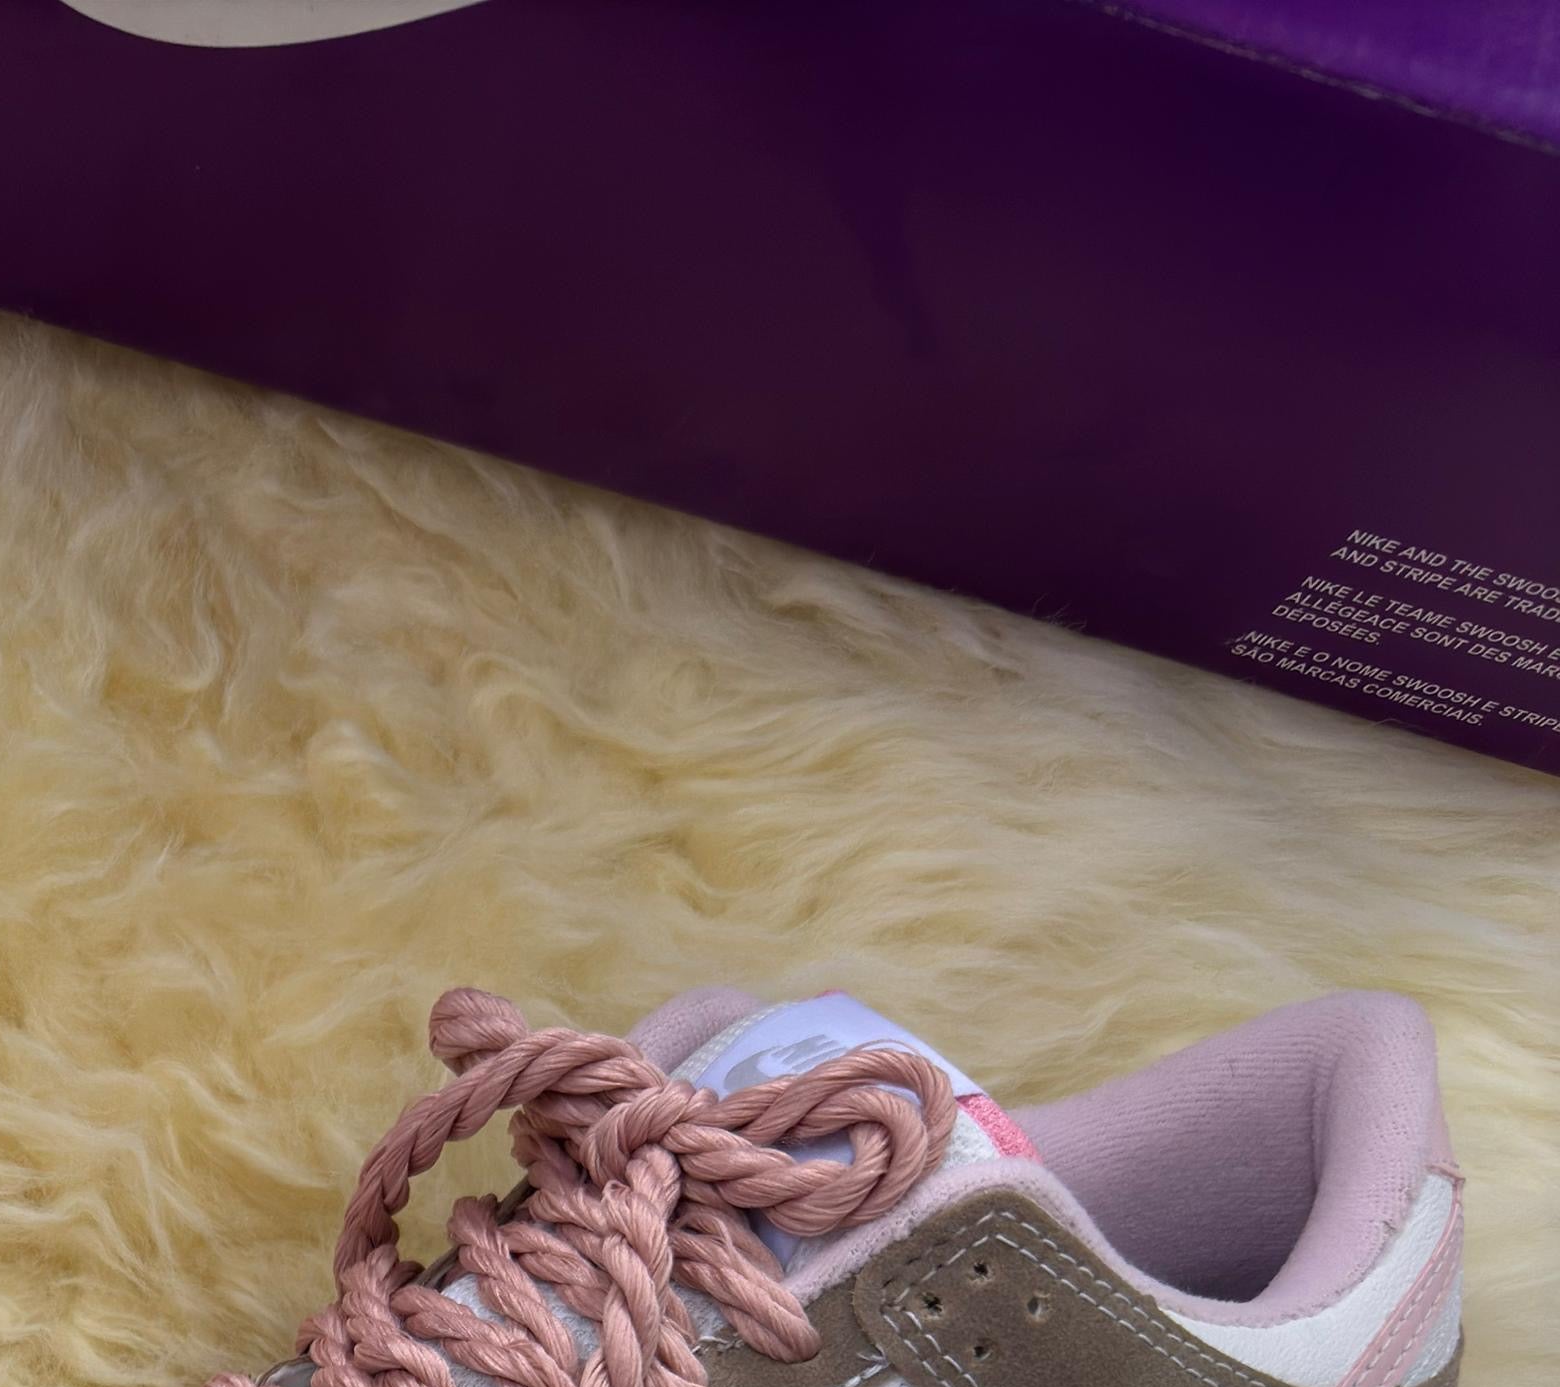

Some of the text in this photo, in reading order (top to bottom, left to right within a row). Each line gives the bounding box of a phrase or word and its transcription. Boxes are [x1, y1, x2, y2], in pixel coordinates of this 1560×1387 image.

[1330, 546, 1378, 567] AND
[1380, 560, 1456, 590] STRIPE
[1454, 582, 1503, 603] ARE
[1347, 530, 1401, 553] NIKE
[1398, 546, 1446, 567] AND
[1450, 559, 1493, 581] THE
[1272, 605, 1382, 645] DÉPOSÉES.
[1285, 591, 1410, 634] ALLÉGEACE
[1410, 626, 1469, 650] SONT
[1467, 643, 1512, 663] DES
[1301, 576, 1353, 598] NIKE
[1352, 591, 1383, 607] LE
[1384, 599, 1456, 628] TEAME
[1456, 621, 1548, 655] SWOOSH
[1231, 644, 1485, 727] SÃO MARCAS COMERCIAIS.
[1244, 631, 1294, 652] NIKE
[1294, 645, 1312, 658] E
[1312, 652, 1330, 663] O
[1331, 656, 1392, 681] NOME
[1392, 675, 1482, 707] SWOOSH
[1481, 701, 1499, 713] E
